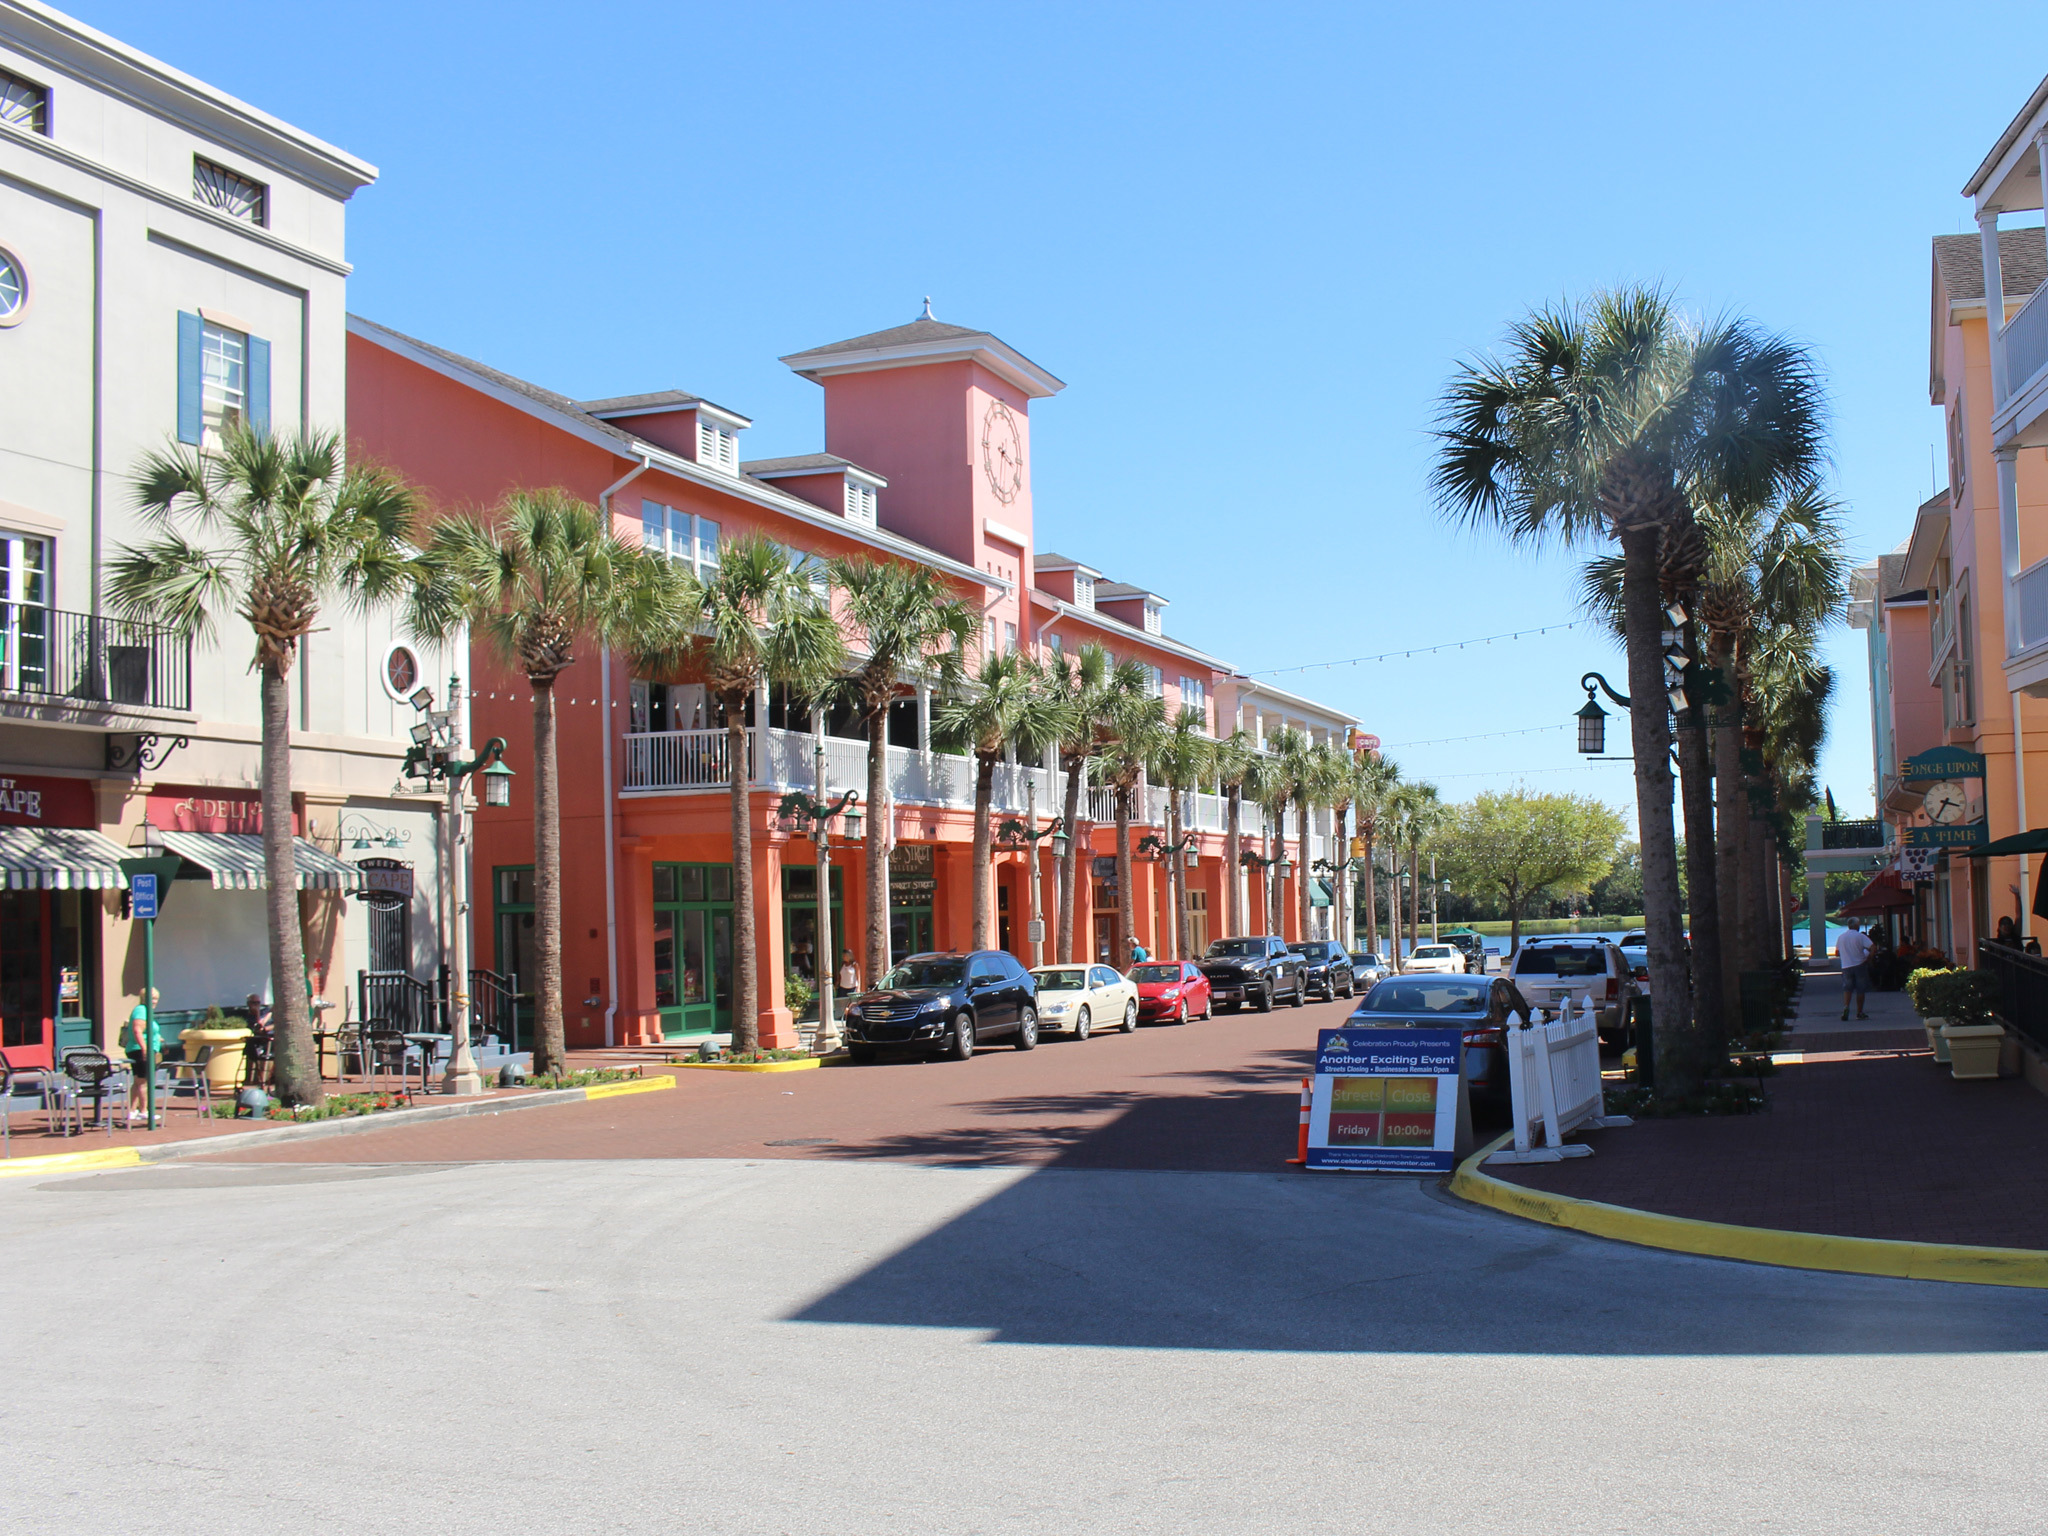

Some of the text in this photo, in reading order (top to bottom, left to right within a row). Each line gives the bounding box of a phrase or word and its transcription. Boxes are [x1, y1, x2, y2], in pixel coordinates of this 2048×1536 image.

[1910, 762, 1979, 774] ONCE UPON
[203, 799, 248, 818] DELI
[1920, 830, 1976, 842] A TIME
[904, 845, 930, 864] STREET
[360, 859, 396, 868] SWEET
[1901, 871, 1935, 881] GRAPE
[136, 878, 152, 888] Post
[912, 880, 934, 890] STREET
[135, 892, 154, 900] Office
[1392, 1040, 1418, 1048] Proudly
[1320, 1056, 1455, 1065] Another Exciting Event
[1333, 1089, 1431, 1103] Streets Close
[1338, 1125, 1370, 1136] Friday
[1321, 1158, 1436, 1167] www.celebrationtowncenter.com
